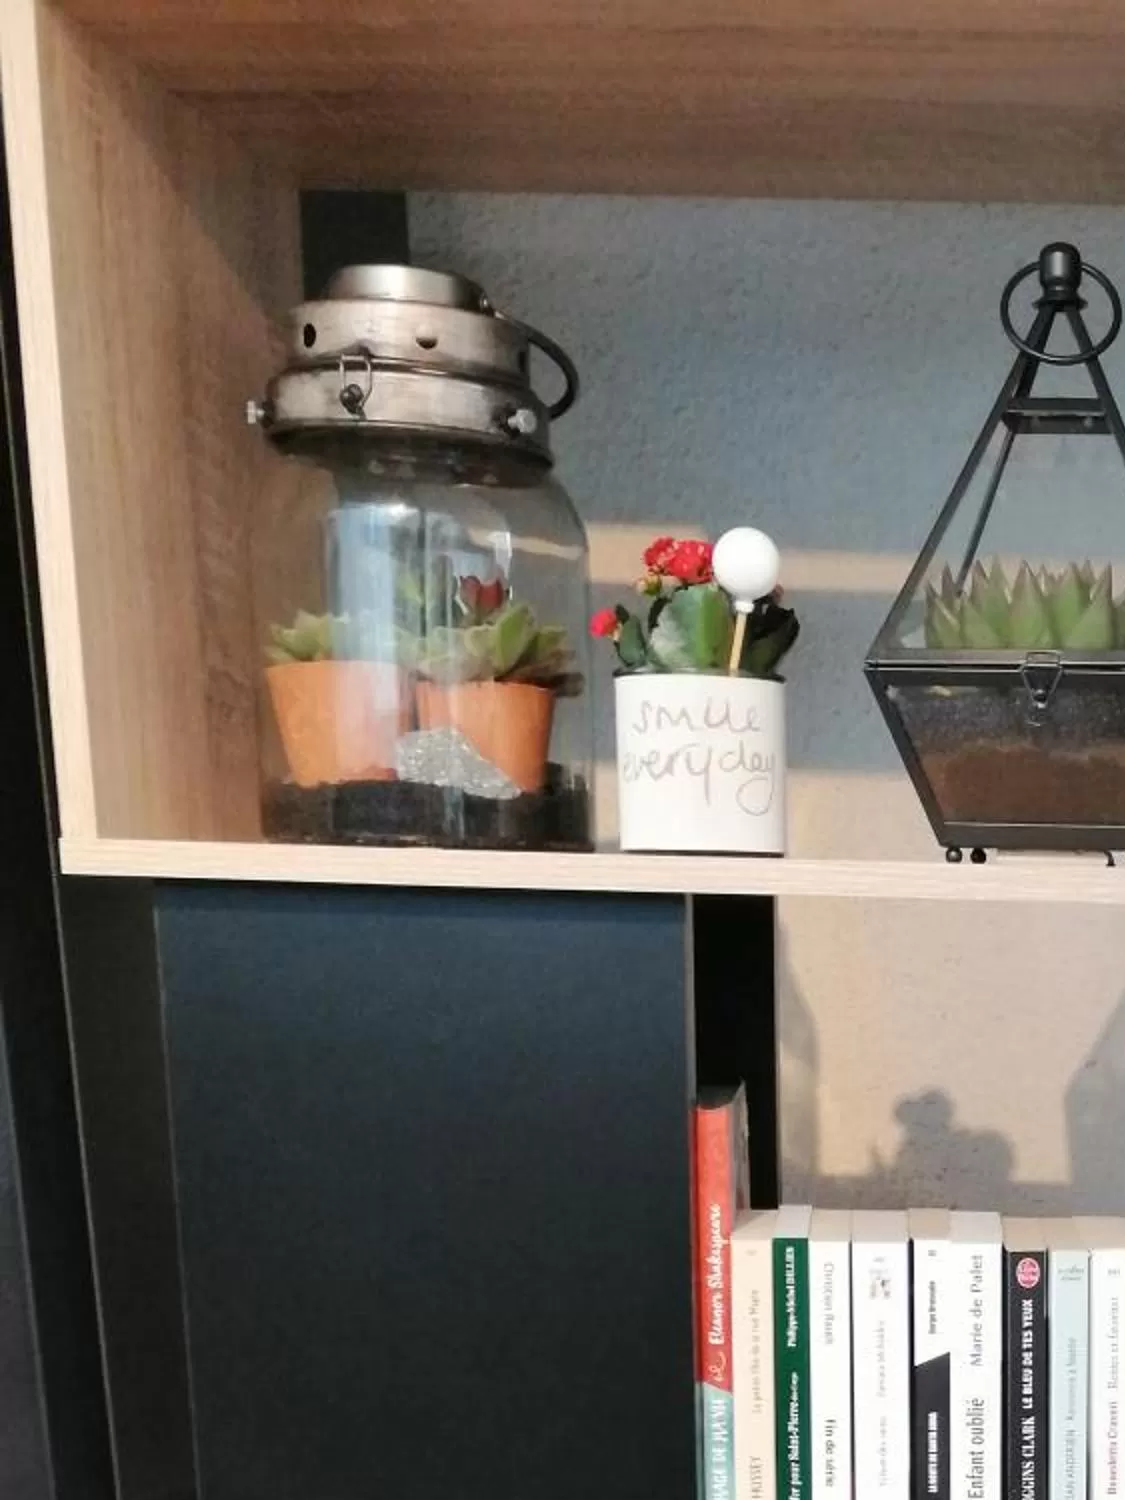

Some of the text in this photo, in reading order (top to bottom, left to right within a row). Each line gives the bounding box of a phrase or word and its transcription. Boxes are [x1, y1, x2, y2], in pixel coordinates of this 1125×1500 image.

[968, 1297, 983, 1320] de
[969, 1321, 984, 1368] Marie
[1021, 1299, 1035, 1410] LE BLEU DE TES YEUX
[965, 1397, 986, 1446] oublié
[1020, 1416, 1036, 1458] CLARK
